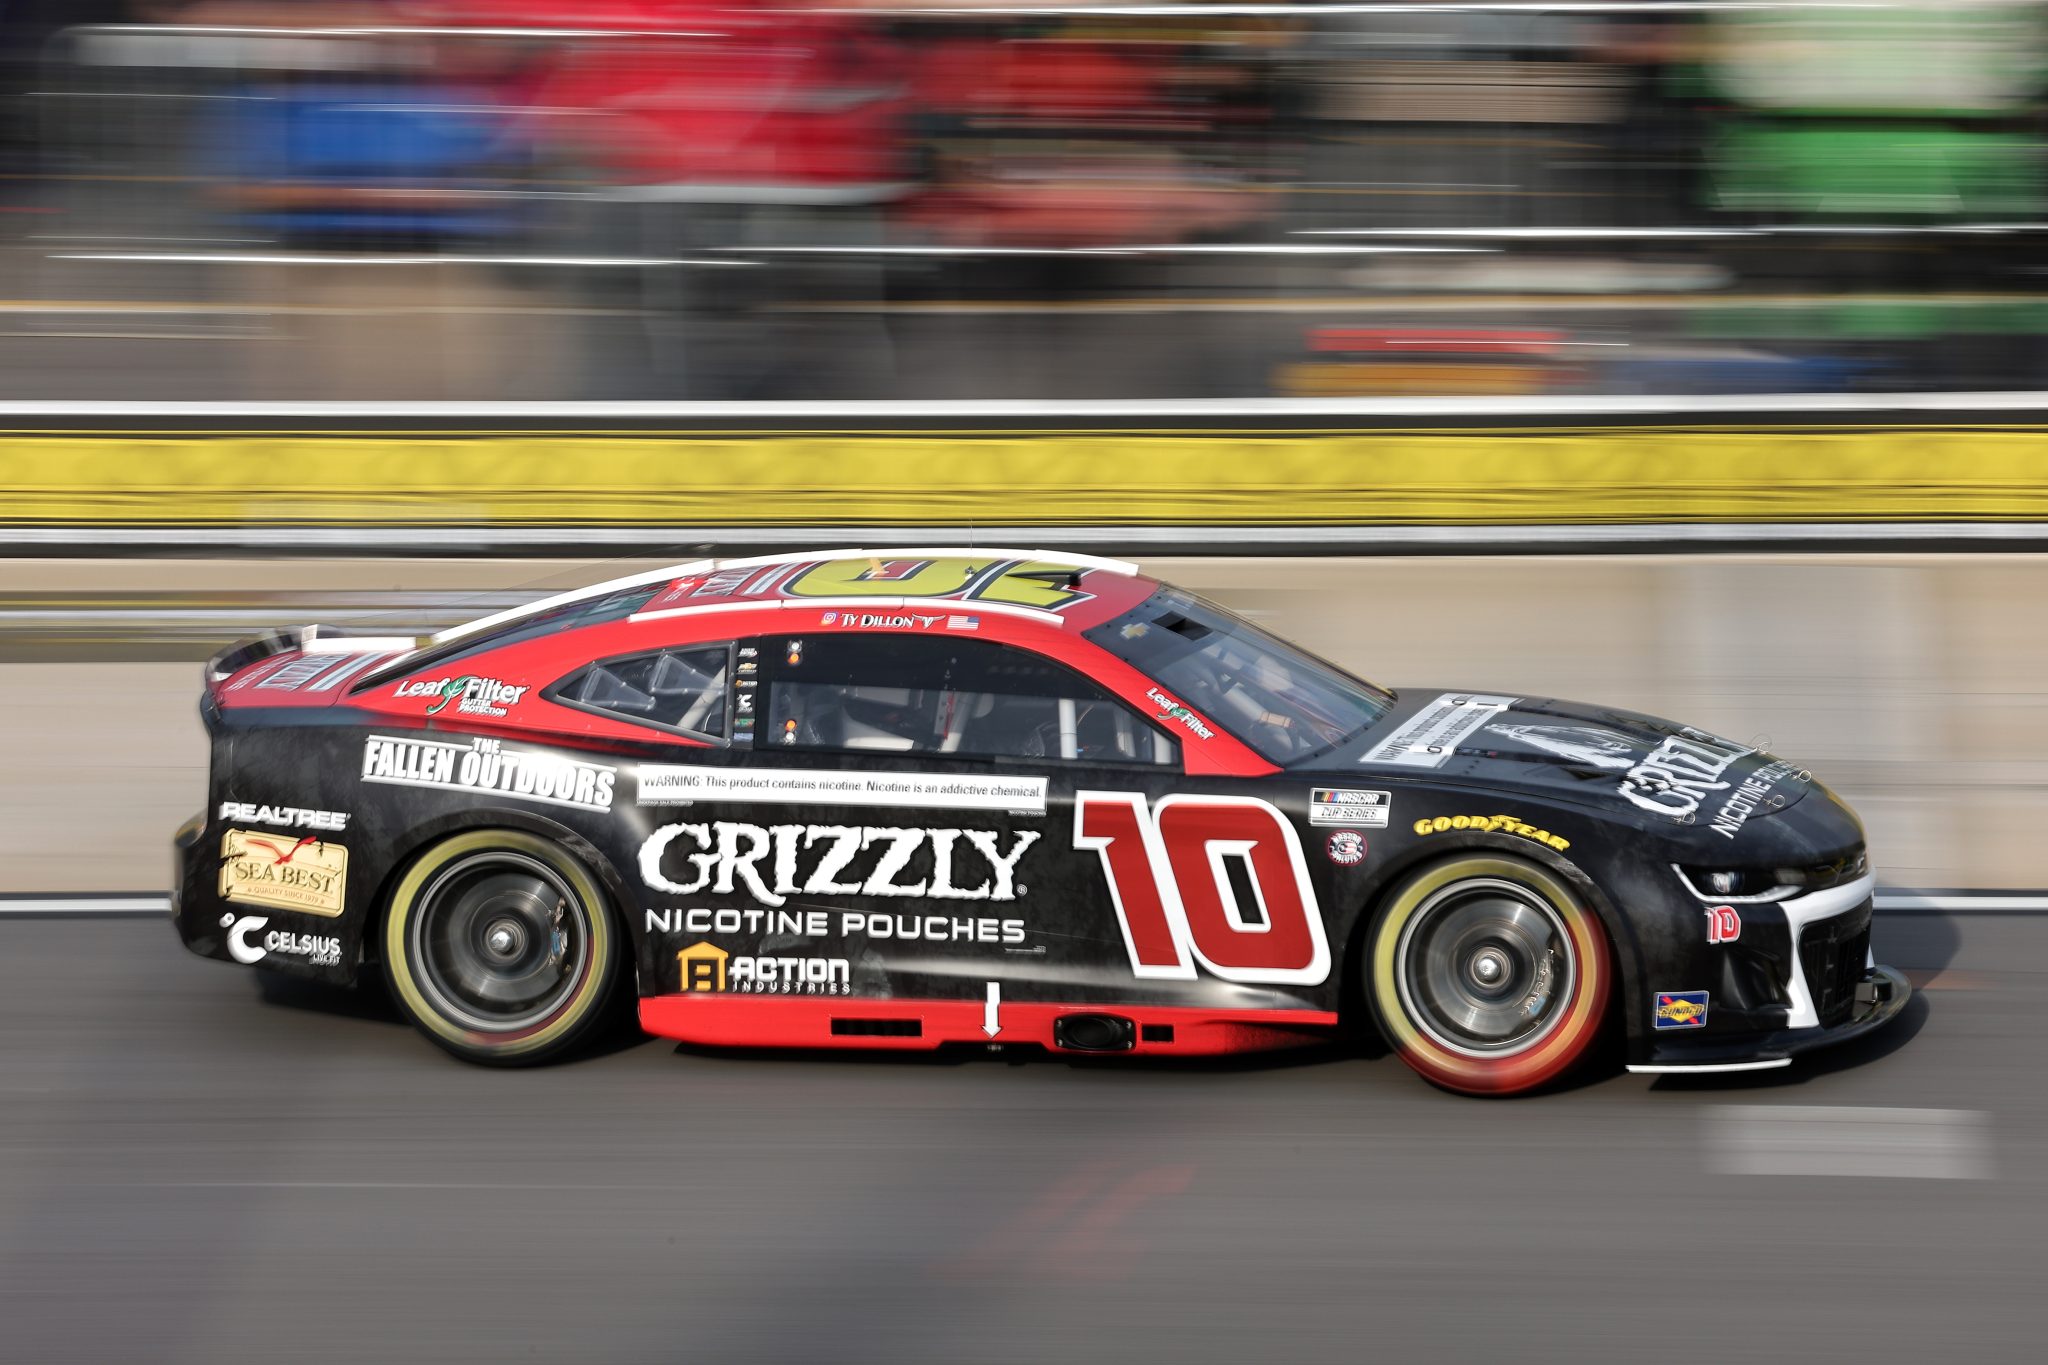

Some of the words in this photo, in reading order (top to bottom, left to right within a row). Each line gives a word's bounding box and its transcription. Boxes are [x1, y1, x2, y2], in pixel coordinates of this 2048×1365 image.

[459, 699, 491, 707] GUTTER
[462, 678, 527, 704] Filter
[457, 704, 508, 717] PROTECTION
[472, 737, 500, 754] THE
[364, 740, 456, 783] FALLEN
[460, 751, 616, 807] OUTDOORS
[644, 775, 703, 787] WARNING:
[705, 776, 727, 787] This
[729, 777, 769, 790] product
[771, 779, 816, 790] contains
[818, 780, 864, 792] nicotine.
[866, 780, 911, 793] Nicotine
[913, 783, 922, 793] is
[924, 785, 938, 794] an
[940, 784, 988, 796] addictive
[990, 785, 1041, 798] chemical.
[1338, 792, 1379, 805] NASCAR
[1709, 777, 1772, 840] NICOTINE
[218, 802, 347, 832] REALTREE
[1343, 807, 1377, 819] SERIES
[1413, 815, 1571, 851] GOODYEAR
[235, 861, 276, 881] SEA
[281, 866, 334, 893] BEST
[637, 820, 1042, 908] GRIZZLY
[253, 886, 282, 894] QUALITY
[284, 889, 302, 899] SINCE
[304, 892, 319, 903] 1979
[1072, 789, 1332, 987] 10
[645, 908, 828, 936] NICOTINE
[842, 912, 1026, 943] POUCHES
[1703, 905, 1742, 945] 10
[264, 930, 341, 957] CELSIUS
[728, 956, 850, 982] ACTION
[732, 981, 851, 995] INDUSTRIES
[1656, 1004, 1705, 1018] SUNOCO
